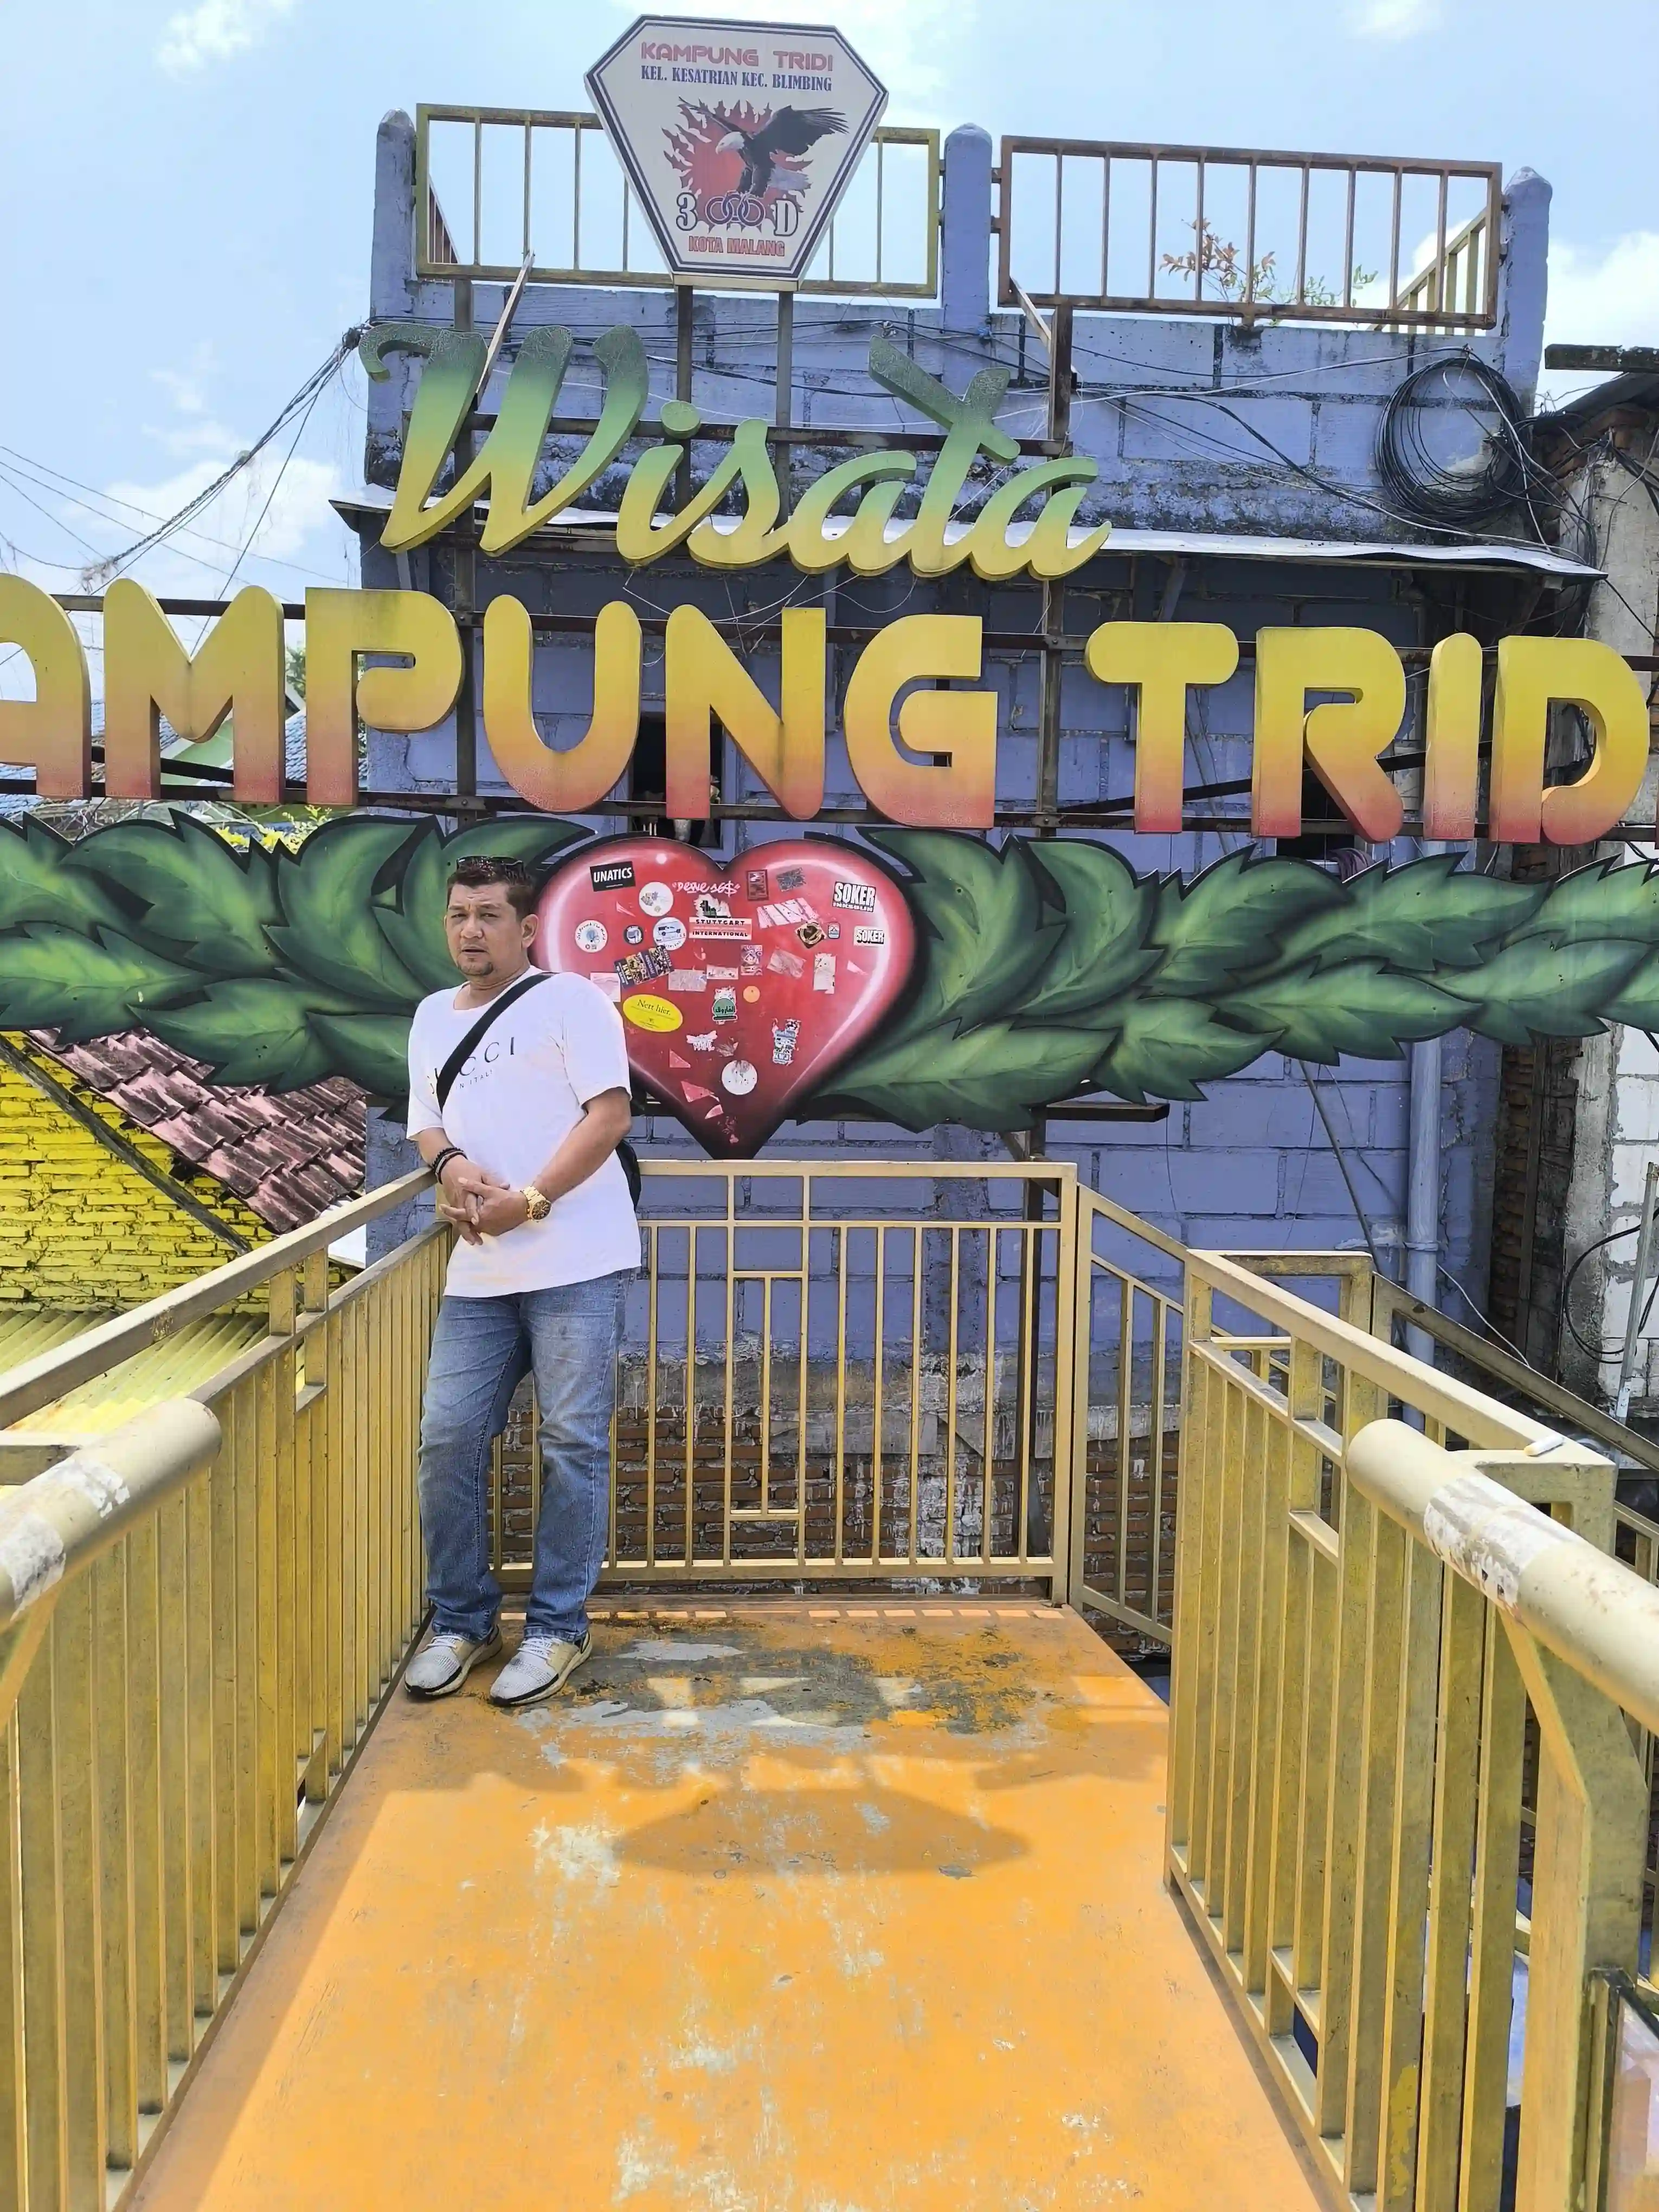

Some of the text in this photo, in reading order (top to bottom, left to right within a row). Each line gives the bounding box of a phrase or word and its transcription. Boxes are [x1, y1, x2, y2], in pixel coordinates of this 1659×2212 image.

[641, 41, 833, 72] KAMPUNG TRIDI
[641, 65, 832, 92] KEL. KESATRIAN KEC. BLIMBING
[676, 192, 799, 236] 3 D
[689, 235, 785, 256] KOTA MALANG
[358, 324, 1112, 581] Wisata
[1086, 621, 1650, 846] TRID
[594, 867, 632, 883] UNATICS
[834, 882, 875, 907] SOKER
[857, 929, 885, 944] SOKER
[637, 999, 654, 1011] Nett
